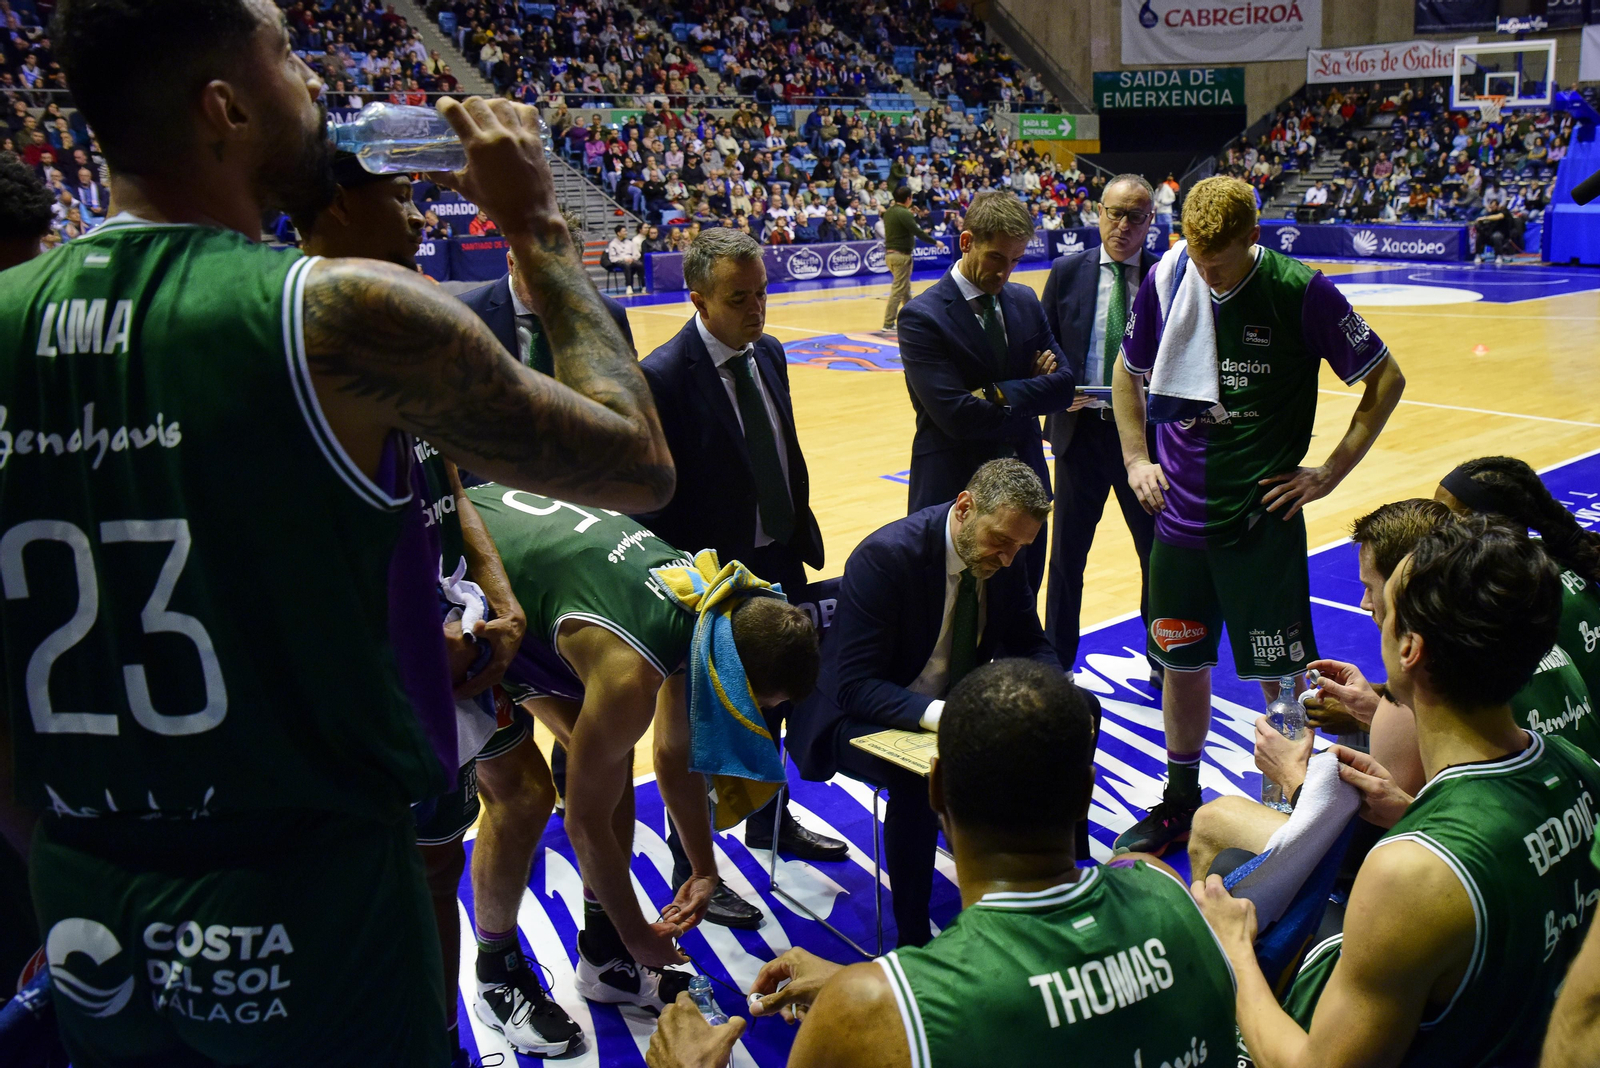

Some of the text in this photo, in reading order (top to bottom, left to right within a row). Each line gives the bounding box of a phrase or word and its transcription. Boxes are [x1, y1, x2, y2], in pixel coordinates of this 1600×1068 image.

[1314, 53, 1341, 76] La
[1381, 49, 1398, 72] de
[1120, 69, 1215, 88] SAIDA DE
[1103, 89, 1233, 108] EMERXENCIA
[430, 202, 479, 216] OBRADO
[461, 241, 493, 251] SANTIAGO
[494, 240, 503, 249] DE
[1381, 237, 1446, 255] Xacobeo
[832, 253, 857, 263] Estrella
[832, 262, 856, 272] Galicia
[36, 299, 133, 357] LIMA
[1217, 357, 1271, 374] dación
[1220, 372, 1249, 390] caja
[0, 518, 228, 736] 23
[1251, 642, 1287, 662] laga
[143, 920, 294, 961] COSTA
[147, 959, 291, 996] DEL SOL
[1028, 937, 1174, 1029] THOMAS
